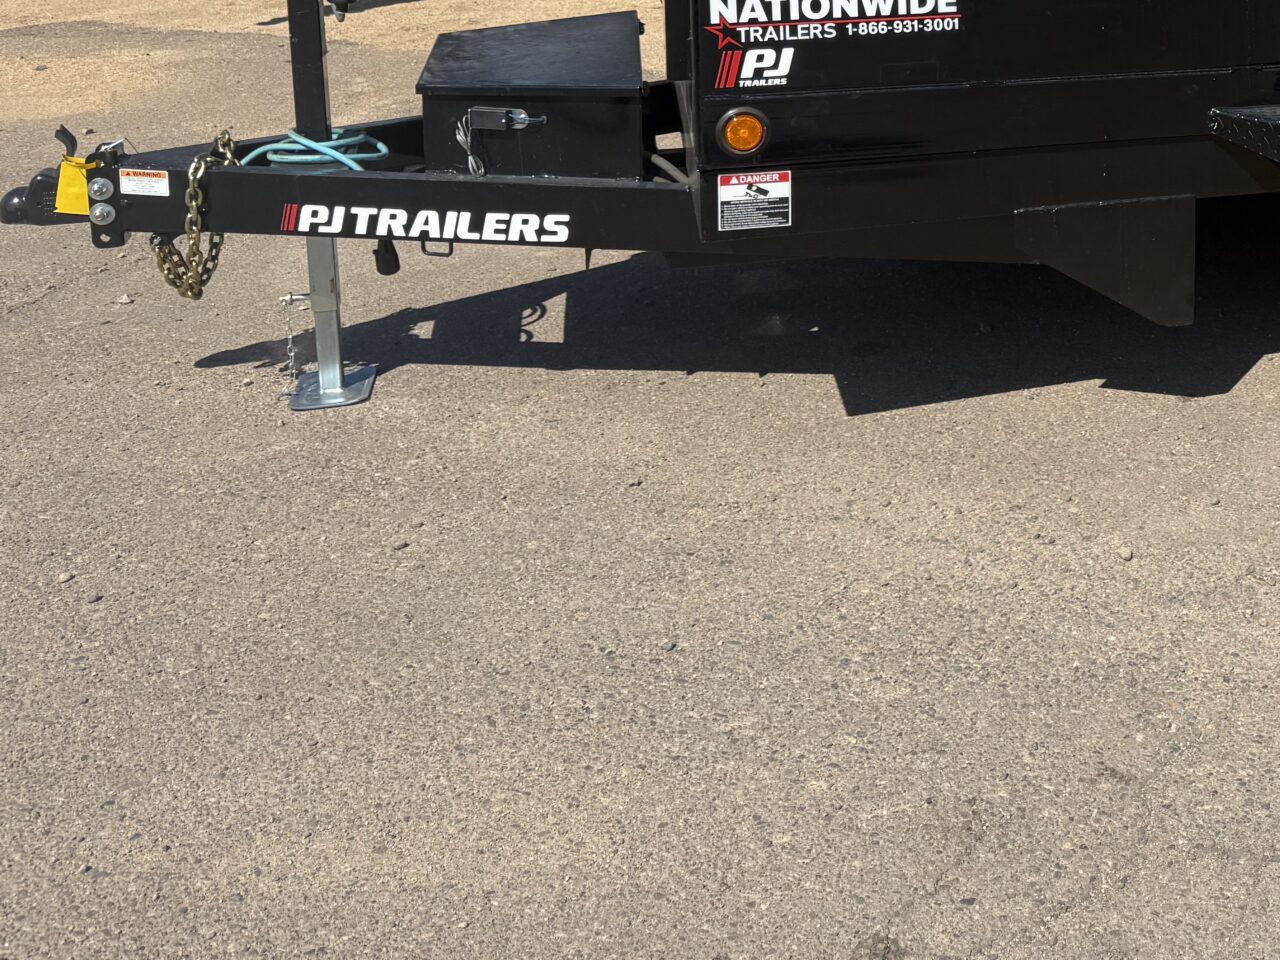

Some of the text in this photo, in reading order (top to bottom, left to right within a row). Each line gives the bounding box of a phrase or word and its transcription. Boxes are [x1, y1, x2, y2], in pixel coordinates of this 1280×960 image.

[736, 18, 960, 44] TRAILERS 1-866-931-3001
[740, 47, 795, 79] PJ
[738, 77, 788, 88] TRAILERS
[132, 170, 162, 178] WARNING
[740, 173, 780, 184] DANGER
[298, 204, 571, 243] PJ TRAILERS
